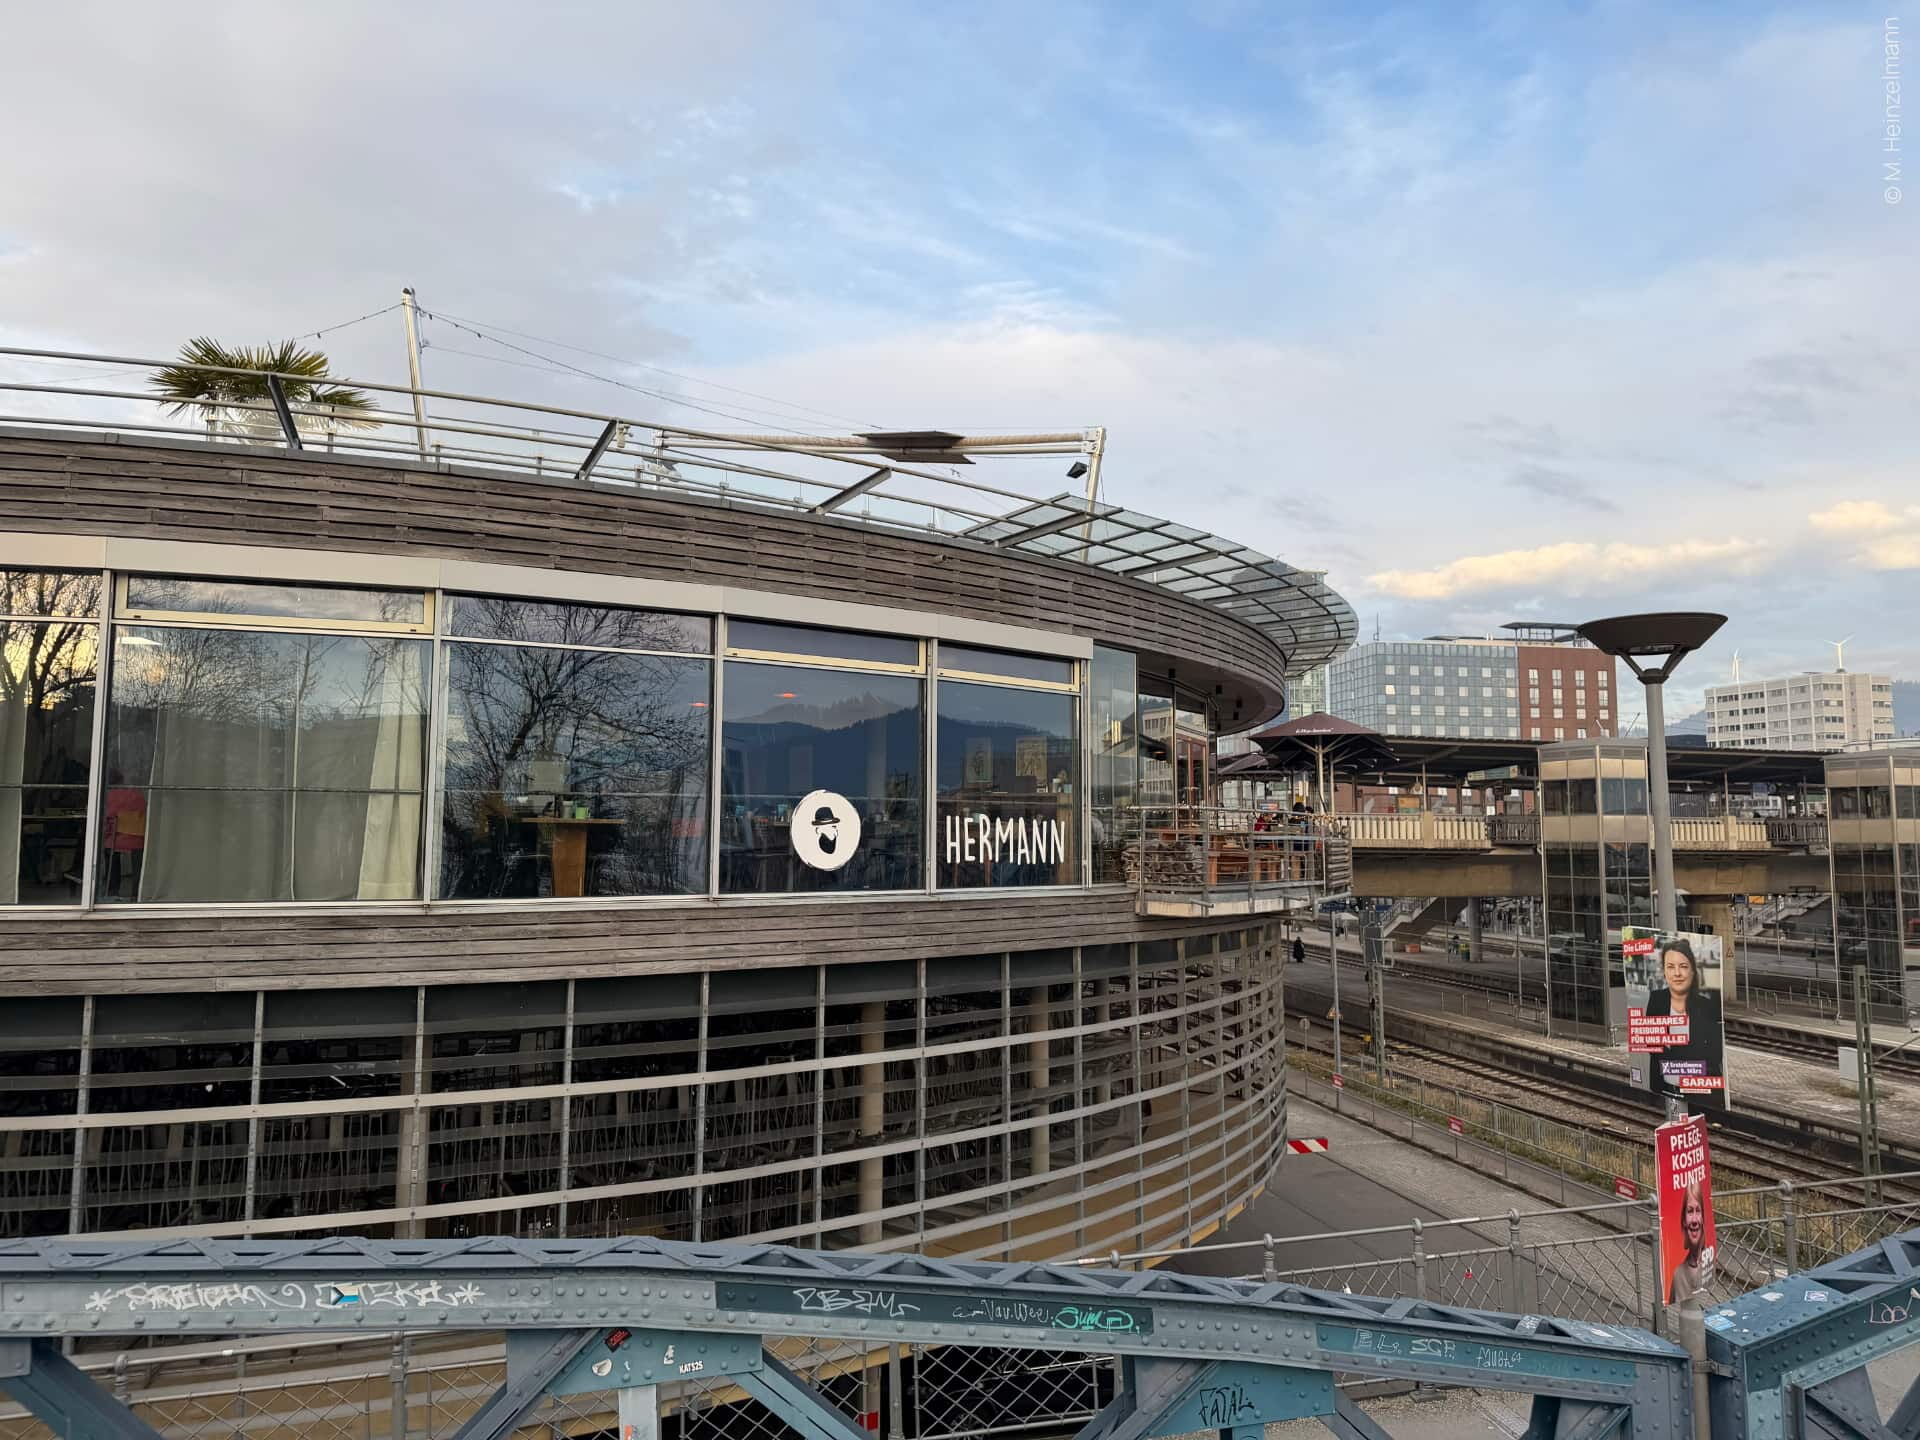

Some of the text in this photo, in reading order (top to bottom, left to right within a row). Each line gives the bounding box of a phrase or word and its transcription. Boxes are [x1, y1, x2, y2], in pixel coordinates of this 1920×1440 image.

[945, 813, 1066, 866] HERMANN
[1623, 941, 1652, 953] Die Linke
[1630, 1017, 1685, 1026] BEZAHLBARES
[1630, 1026, 1666, 1035] FREIBURG
[1630, 1034, 1686, 1044] FÜR UNS ALLE!
[1682, 1077, 1722, 1088] SARAH
[1672, 1144, 1704, 1171] KOSTEN
[1672, 1164, 1706, 1191] RUNTER
[1701, 1245, 1715, 1268] SPD
